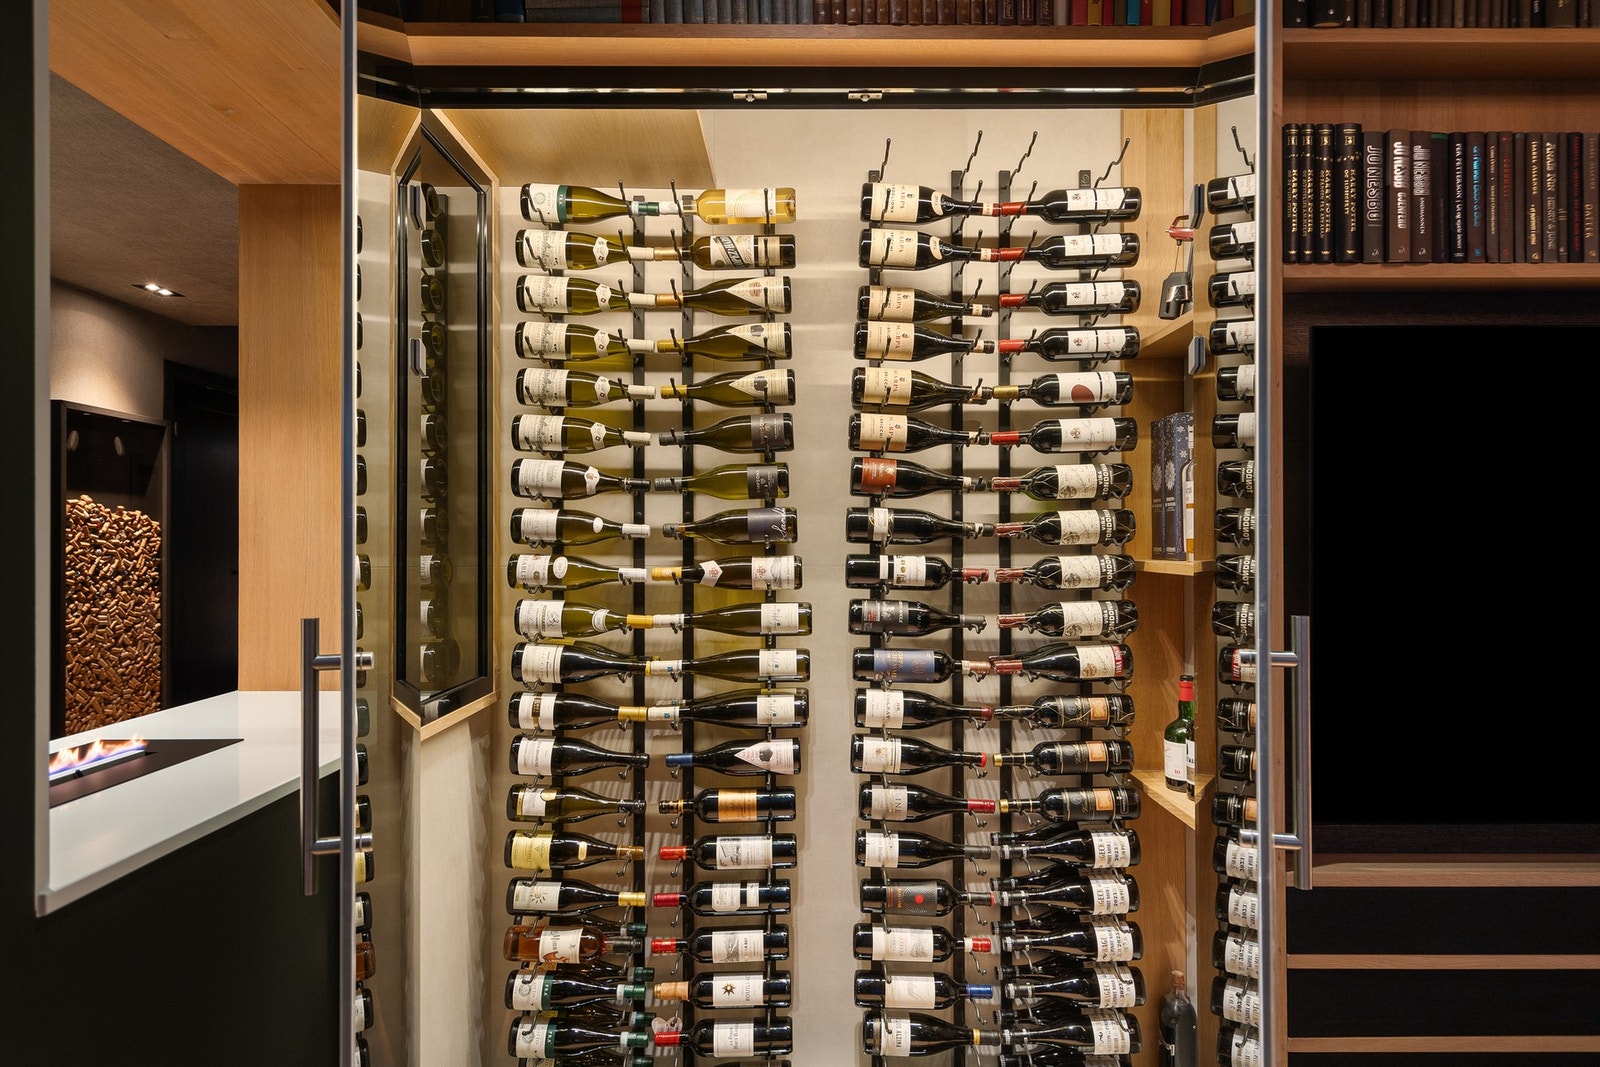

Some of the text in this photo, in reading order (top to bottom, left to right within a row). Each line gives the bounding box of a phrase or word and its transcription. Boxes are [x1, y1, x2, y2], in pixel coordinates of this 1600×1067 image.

[1367, 145, 1383, 165] JO
[1393, 141, 1409, 155] JO
[1413, 145, 1430, 160] JO
[1455, 143, 1463, 157] PER
[1531, 141, 1539, 163] ISABEL
[1455, 158, 1463, 198] PETTERSON
[1546, 173, 1556, 191] NIN
[1367, 167, 1383, 221] NESBØ
[1547, 196, 1556, 222] HENRY
[1584, 203, 1594, 239] DATTER
[1546, 230, 1556, 250] JUNE
